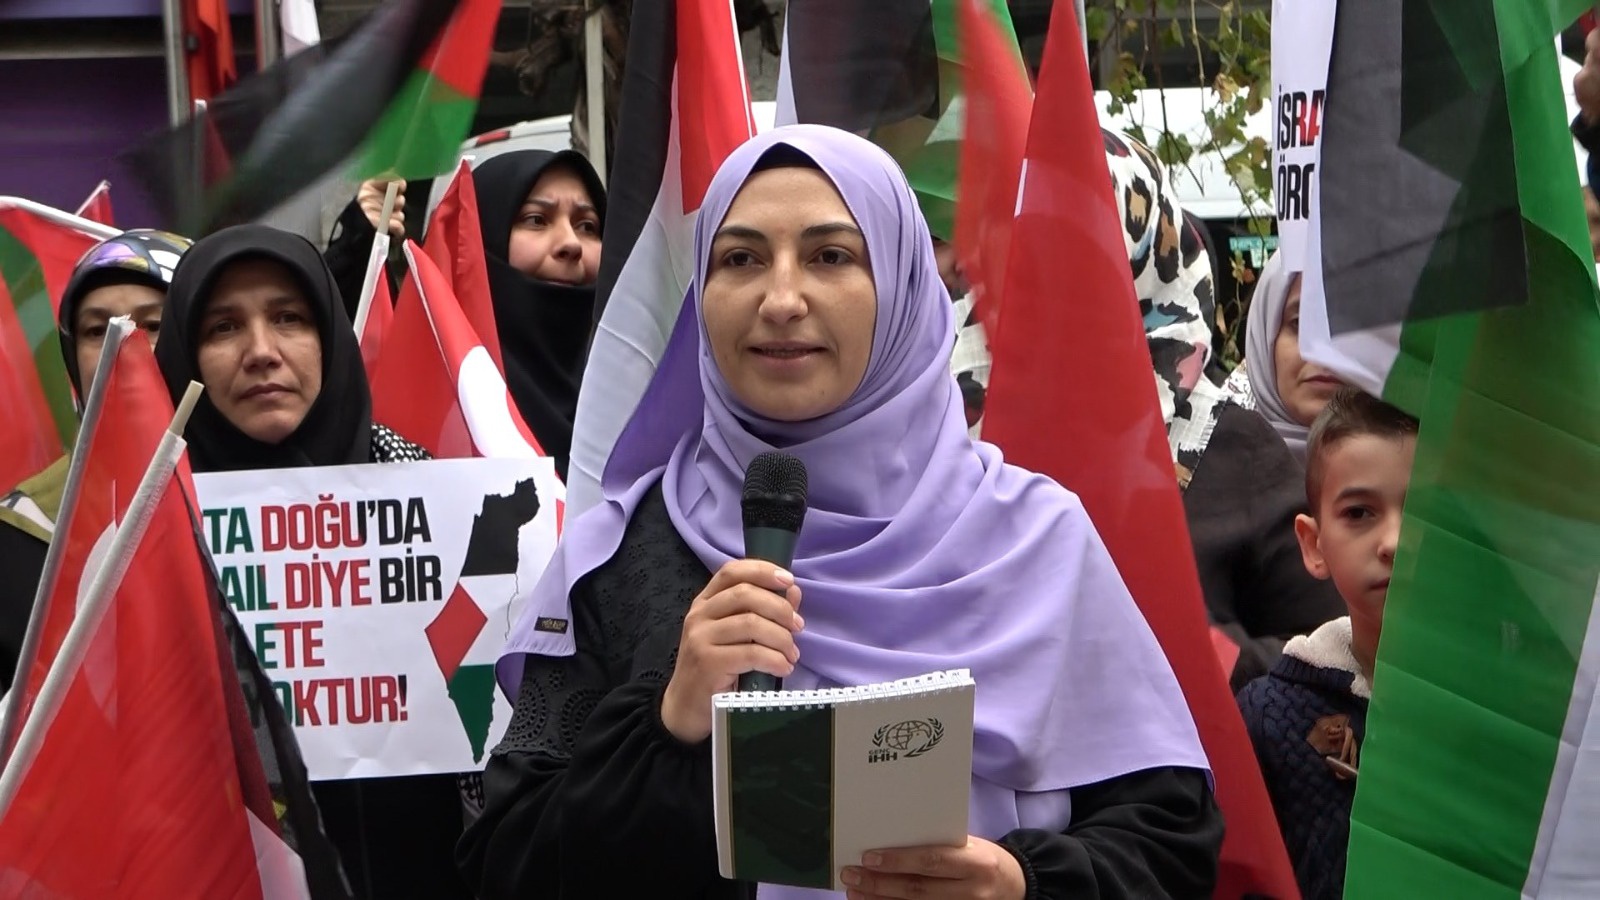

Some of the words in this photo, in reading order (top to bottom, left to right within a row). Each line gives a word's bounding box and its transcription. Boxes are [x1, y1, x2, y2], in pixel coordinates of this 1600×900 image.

[261, 494, 431, 552] DOĞU'DA
[284, 553, 372, 610] DİYE
[379, 547, 442, 604] BİR
[241, 621, 324, 669] ETE
